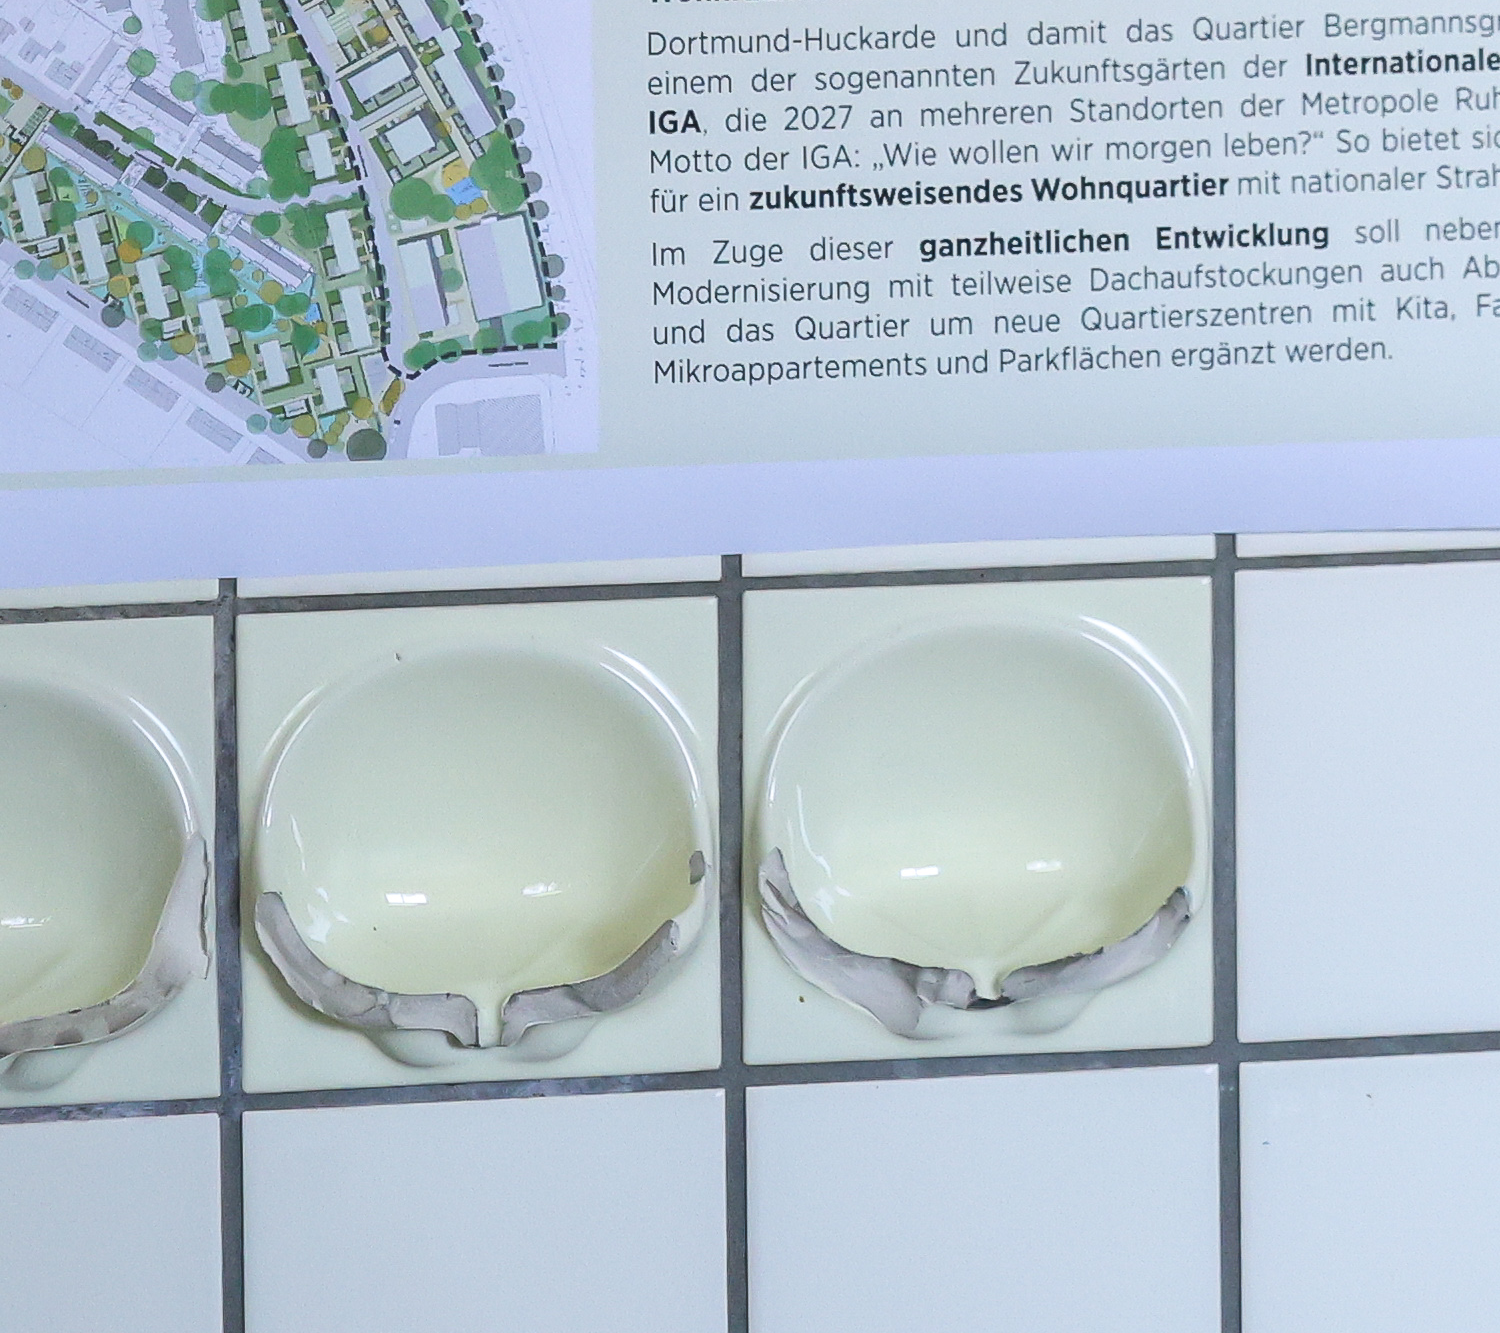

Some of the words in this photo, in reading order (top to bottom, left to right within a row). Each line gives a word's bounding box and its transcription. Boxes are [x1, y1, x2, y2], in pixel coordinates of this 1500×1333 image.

[647, 23, 936, 56] Dortmund-Huckarde
[955, 21, 1008, 49] und
[1027, 20, 1107, 46] damit
[1126, 18, 1174, 44] das
[1192, 16, 1305, 42] Quartier
[650, 188, 689, 214] für
[698, 192, 739, 212] ein
[748, 179, 1024, 210] zukunftsweisendes
[1030, 172, 1230, 206] Wohnquartier
[1238, 172, 1281, 195] mit
[1292, 167, 1427, 194] nationaler
[654, 352, 928, 386] Mikroappartements
[937, 348, 988, 375] und
[999, 344, 1161, 373] Parkflächen
[1171, 341, 1276, 371] ergänzt
[1285, 337, 1394, 363] werden.
